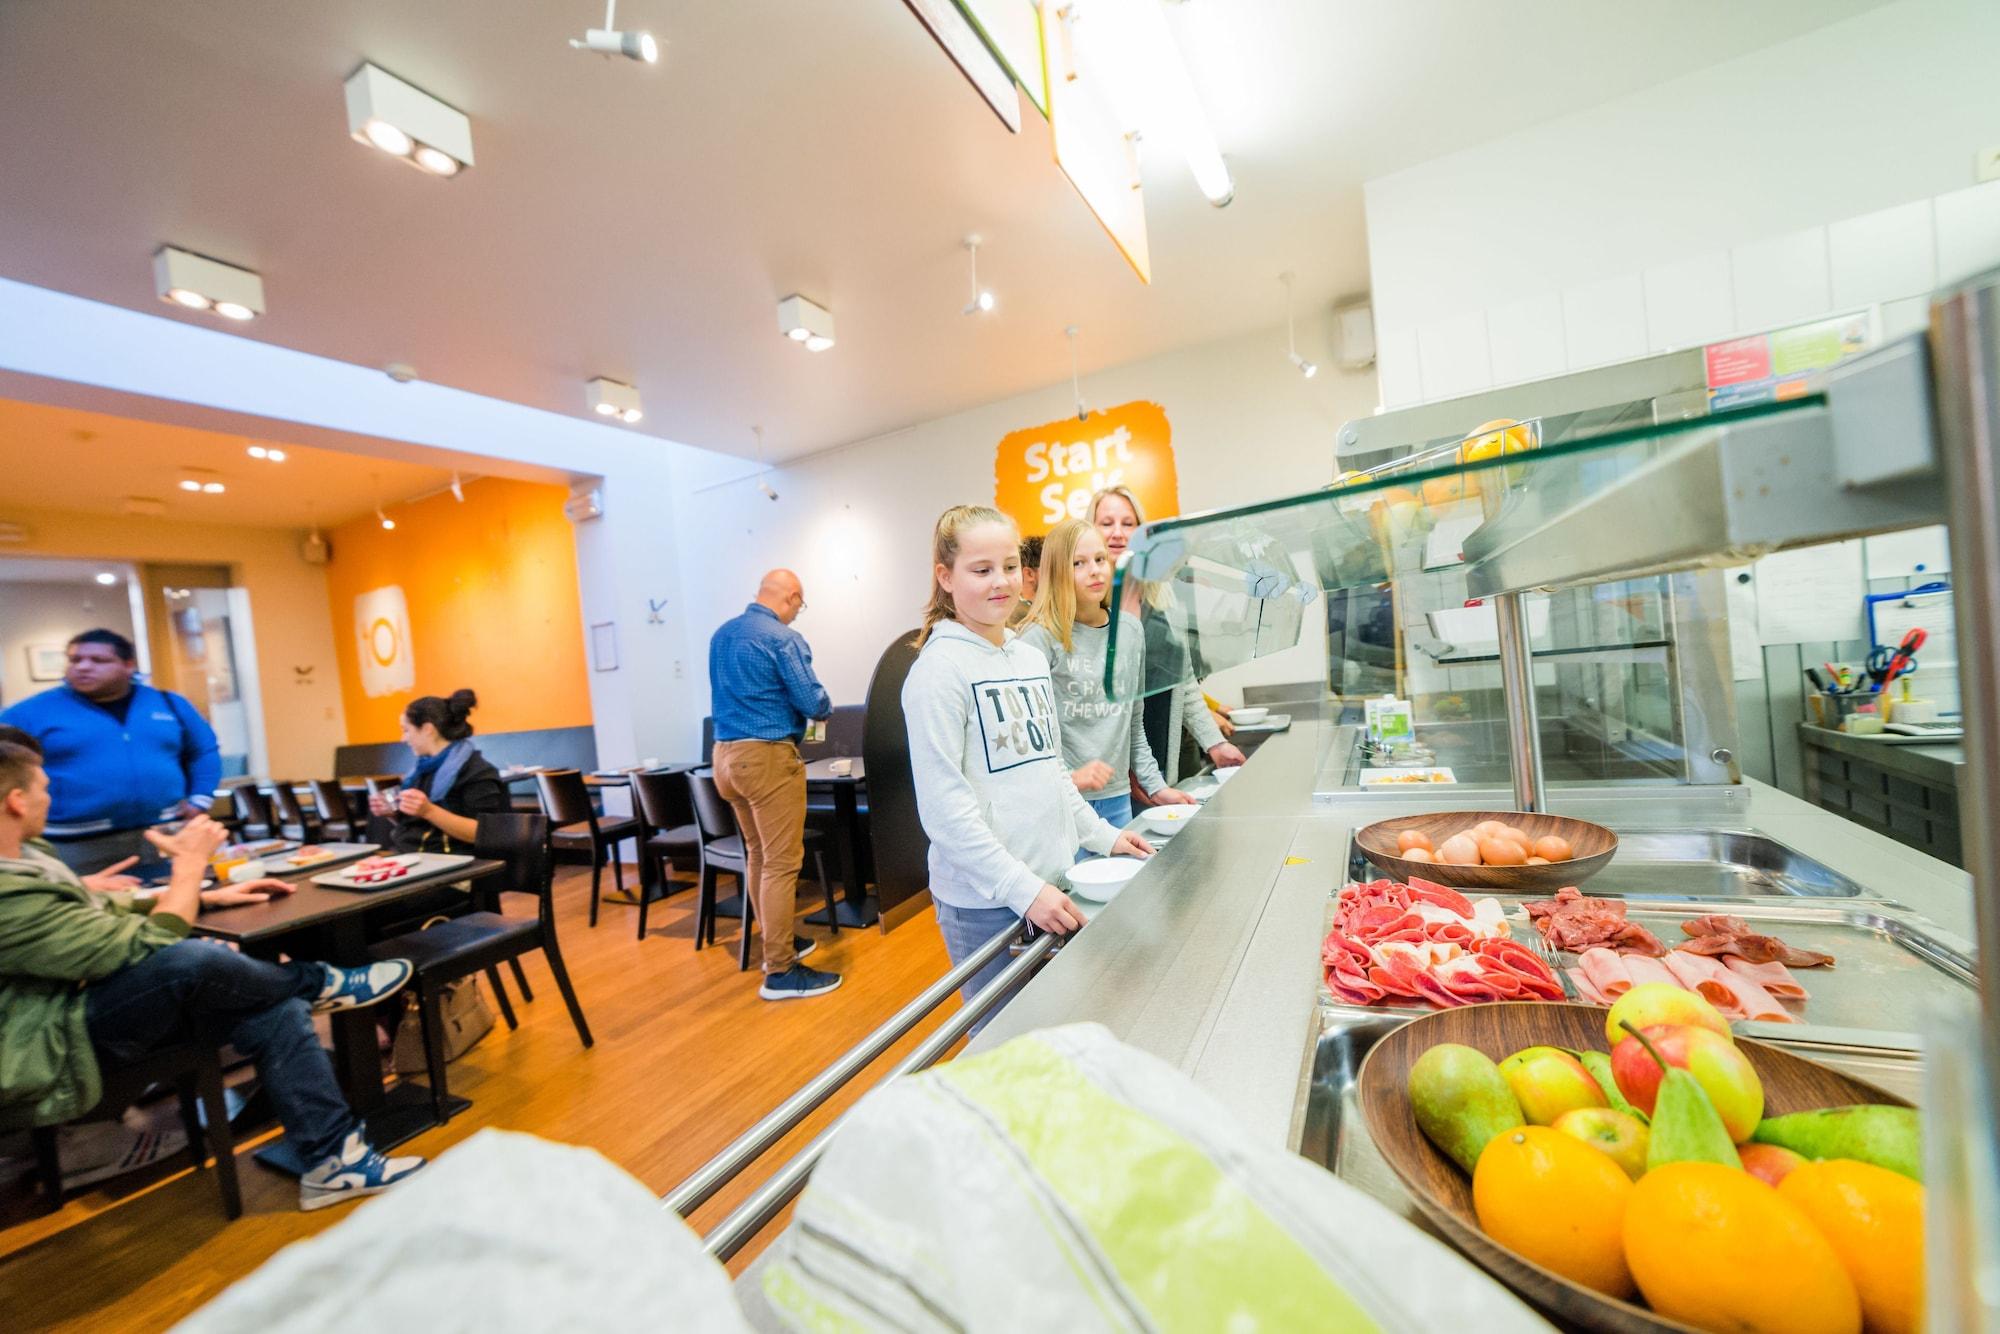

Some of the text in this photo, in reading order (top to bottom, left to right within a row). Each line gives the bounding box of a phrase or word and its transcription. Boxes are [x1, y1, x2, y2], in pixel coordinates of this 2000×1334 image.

[1024, 425, 1132, 483] Start
[1066, 658, 1094, 673] WE
[1062, 701, 1092, 719] THE
